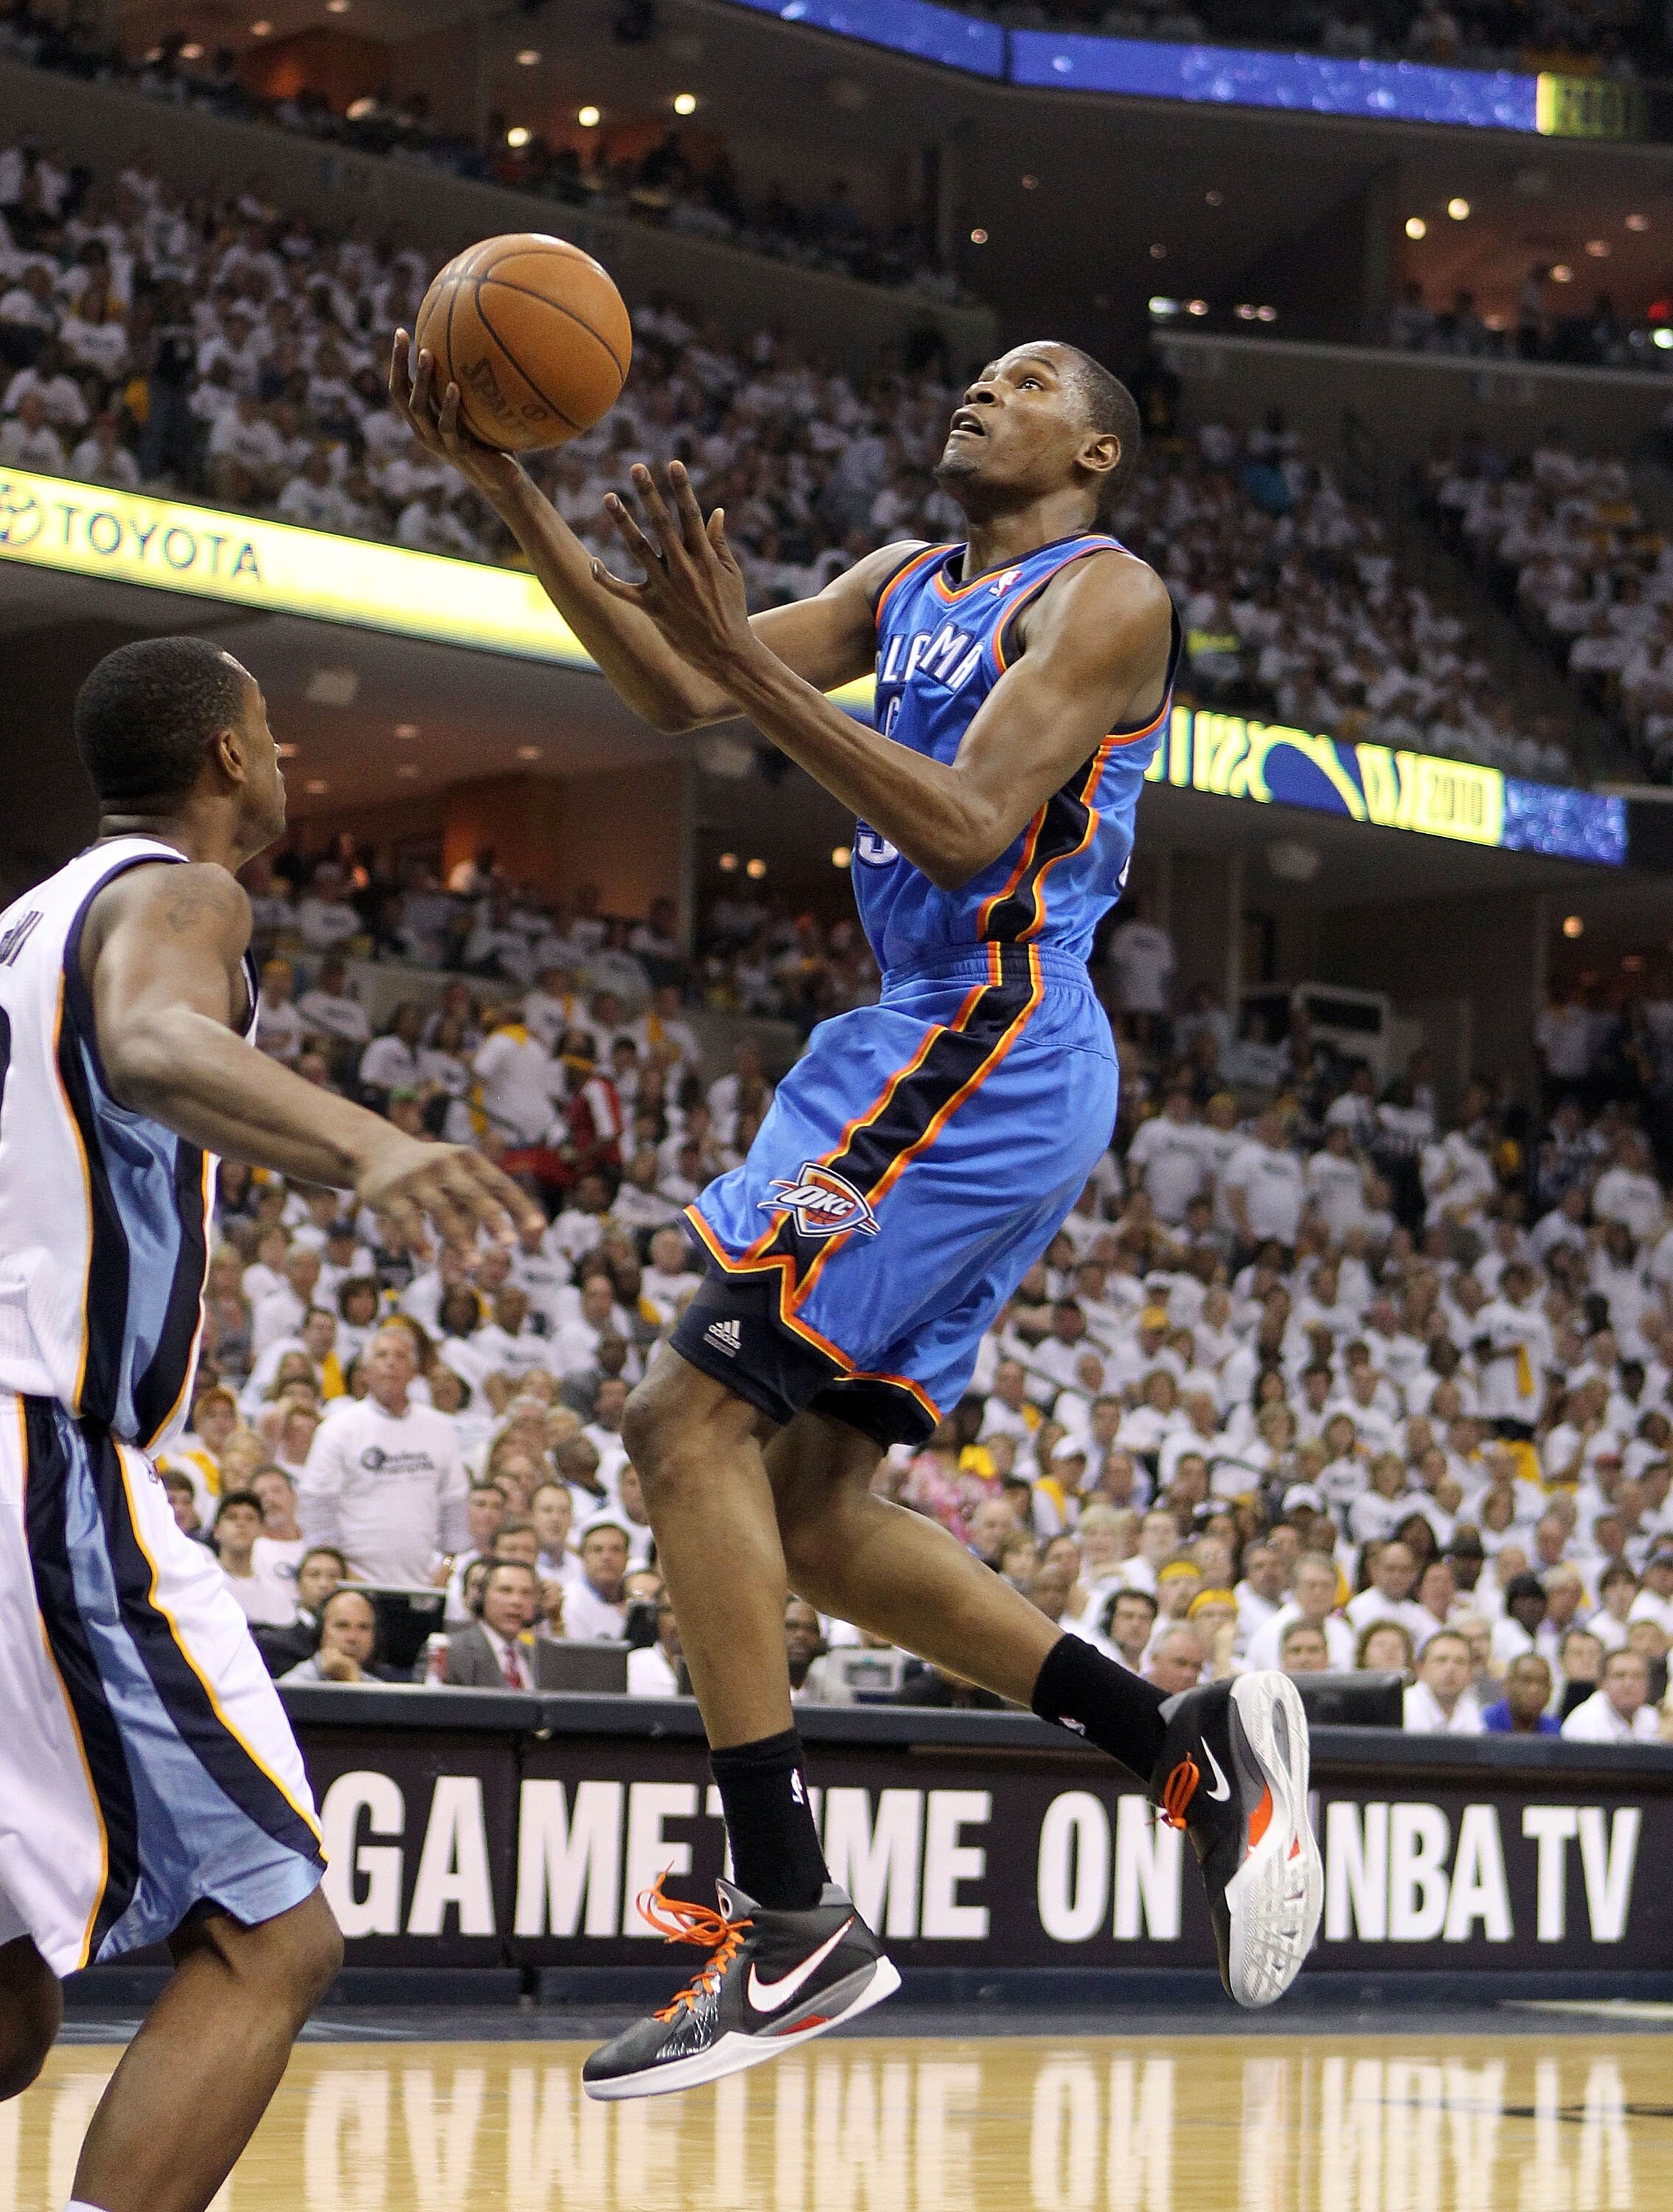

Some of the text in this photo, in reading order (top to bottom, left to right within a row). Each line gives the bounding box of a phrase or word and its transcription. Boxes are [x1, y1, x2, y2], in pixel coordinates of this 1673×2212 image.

[55, 504, 262, 582] TOYOTA
[778, 1183, 857, 1217] OKC
[708, 1324, 742, 1350] adidas
[319, 1770, 1643, 1944] GAMEME ON NBA TV
